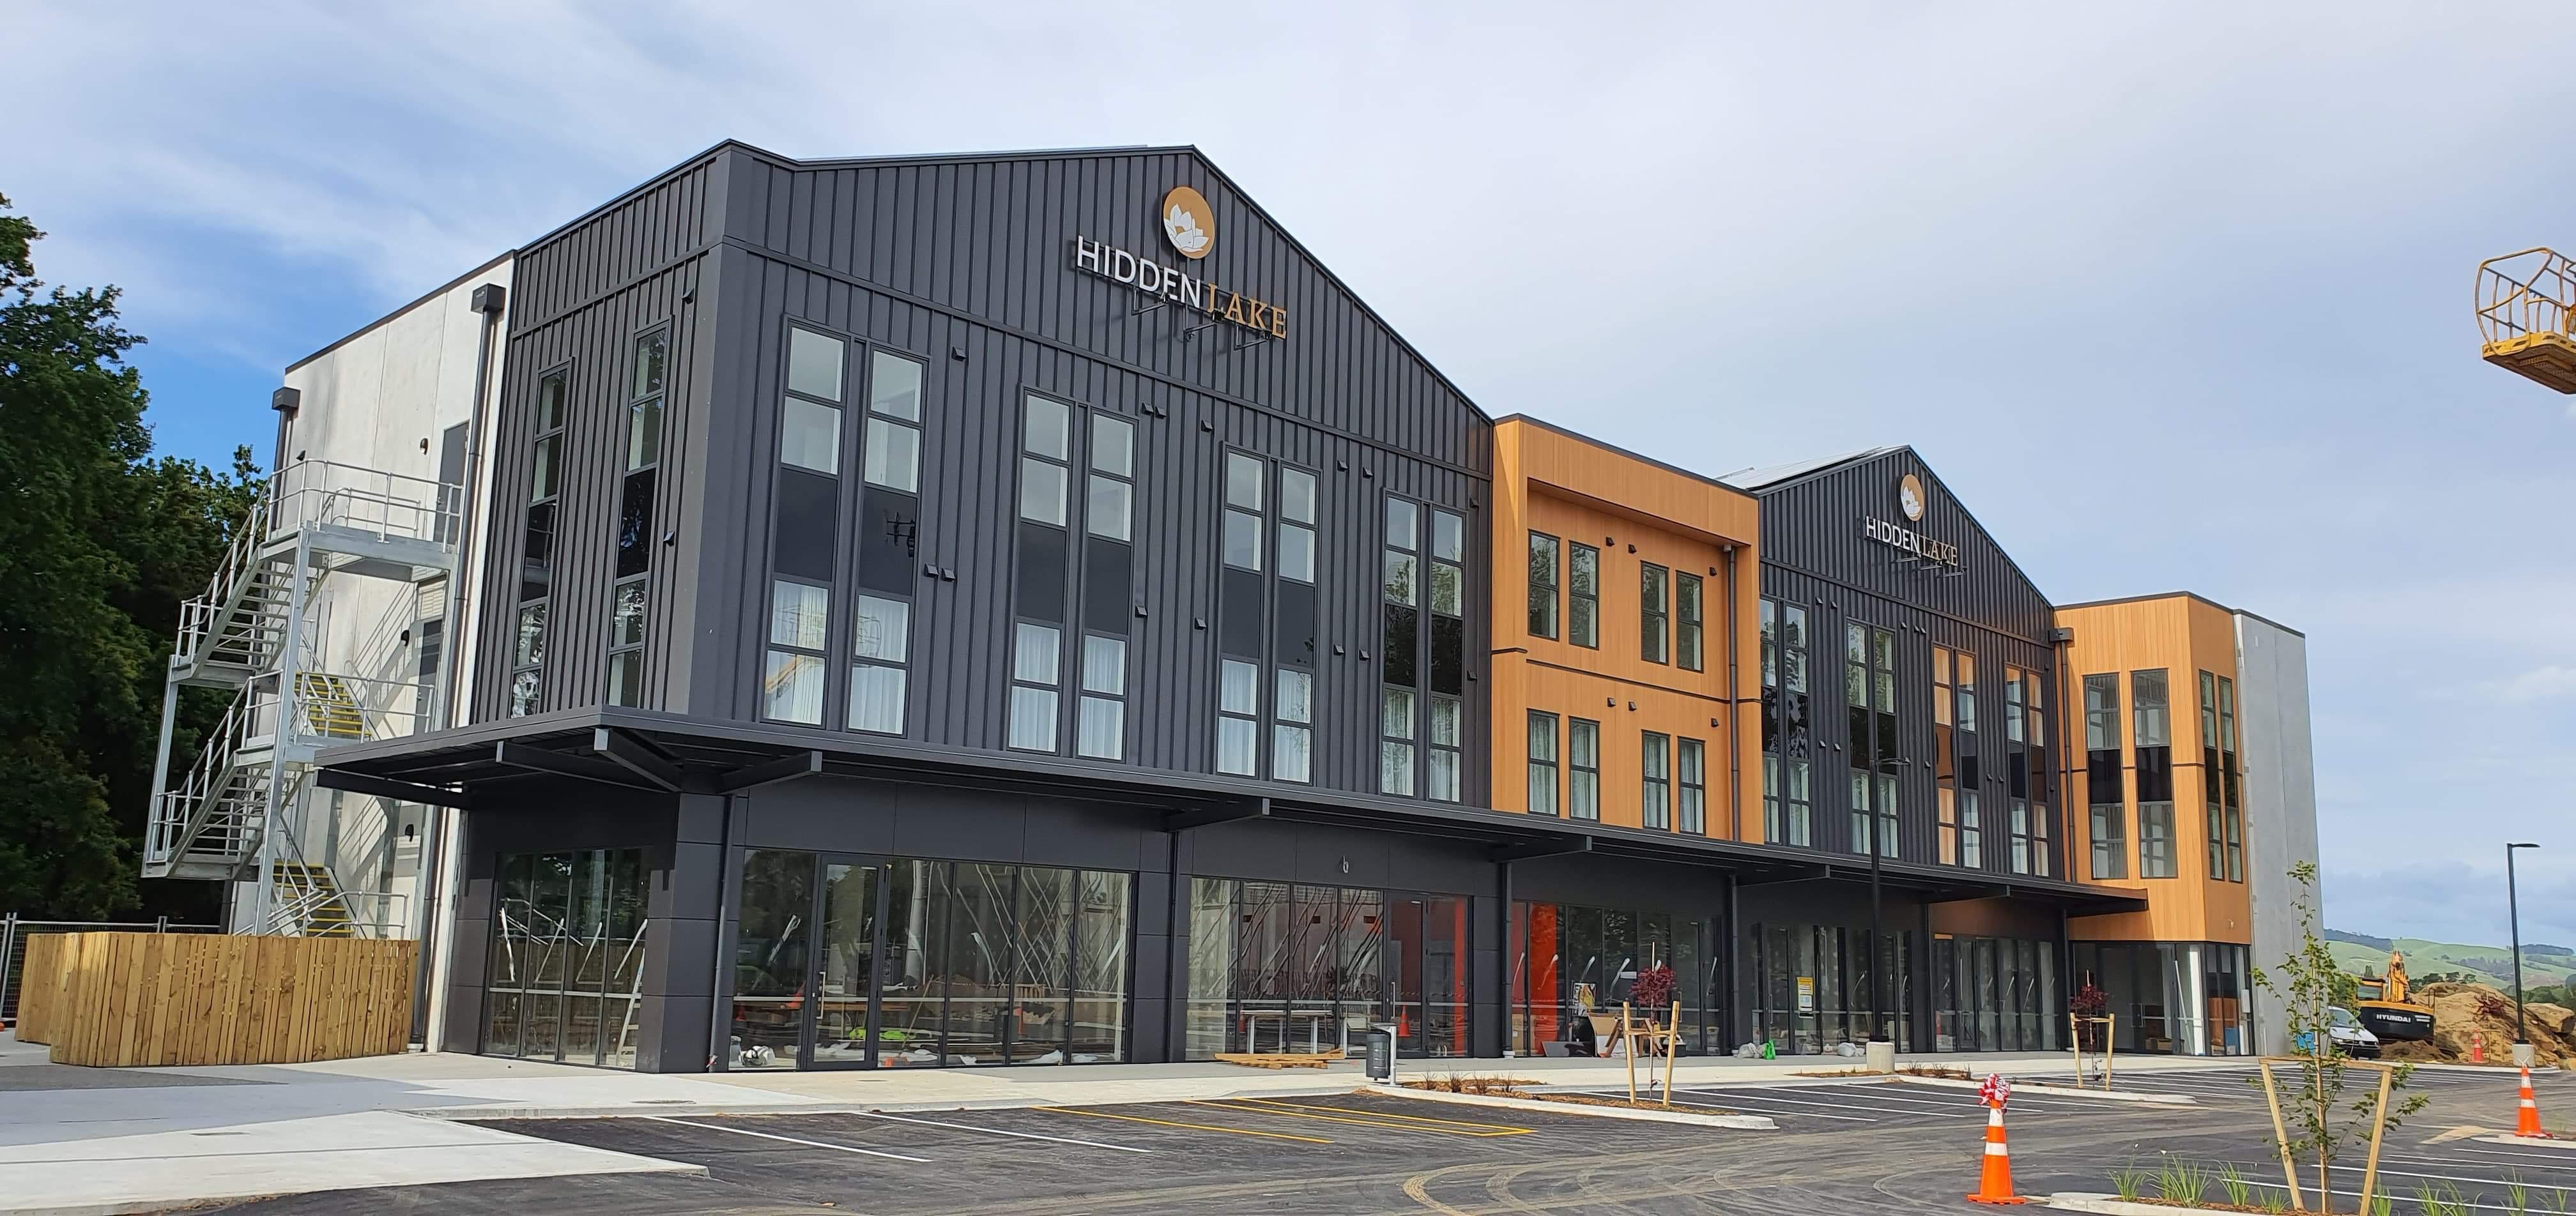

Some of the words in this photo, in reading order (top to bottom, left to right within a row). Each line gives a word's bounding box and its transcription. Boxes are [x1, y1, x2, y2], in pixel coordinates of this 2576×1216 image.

[1077, 234, 1201, 309] HIDDEN
[1206, 282, 1287, 339] LAKE
[1866, 515, 1920, 554] HIDDEN
[1920, 535, 1958, 567] LAKE
[2376, 1014, 2411, 1023] HYUNDAI
